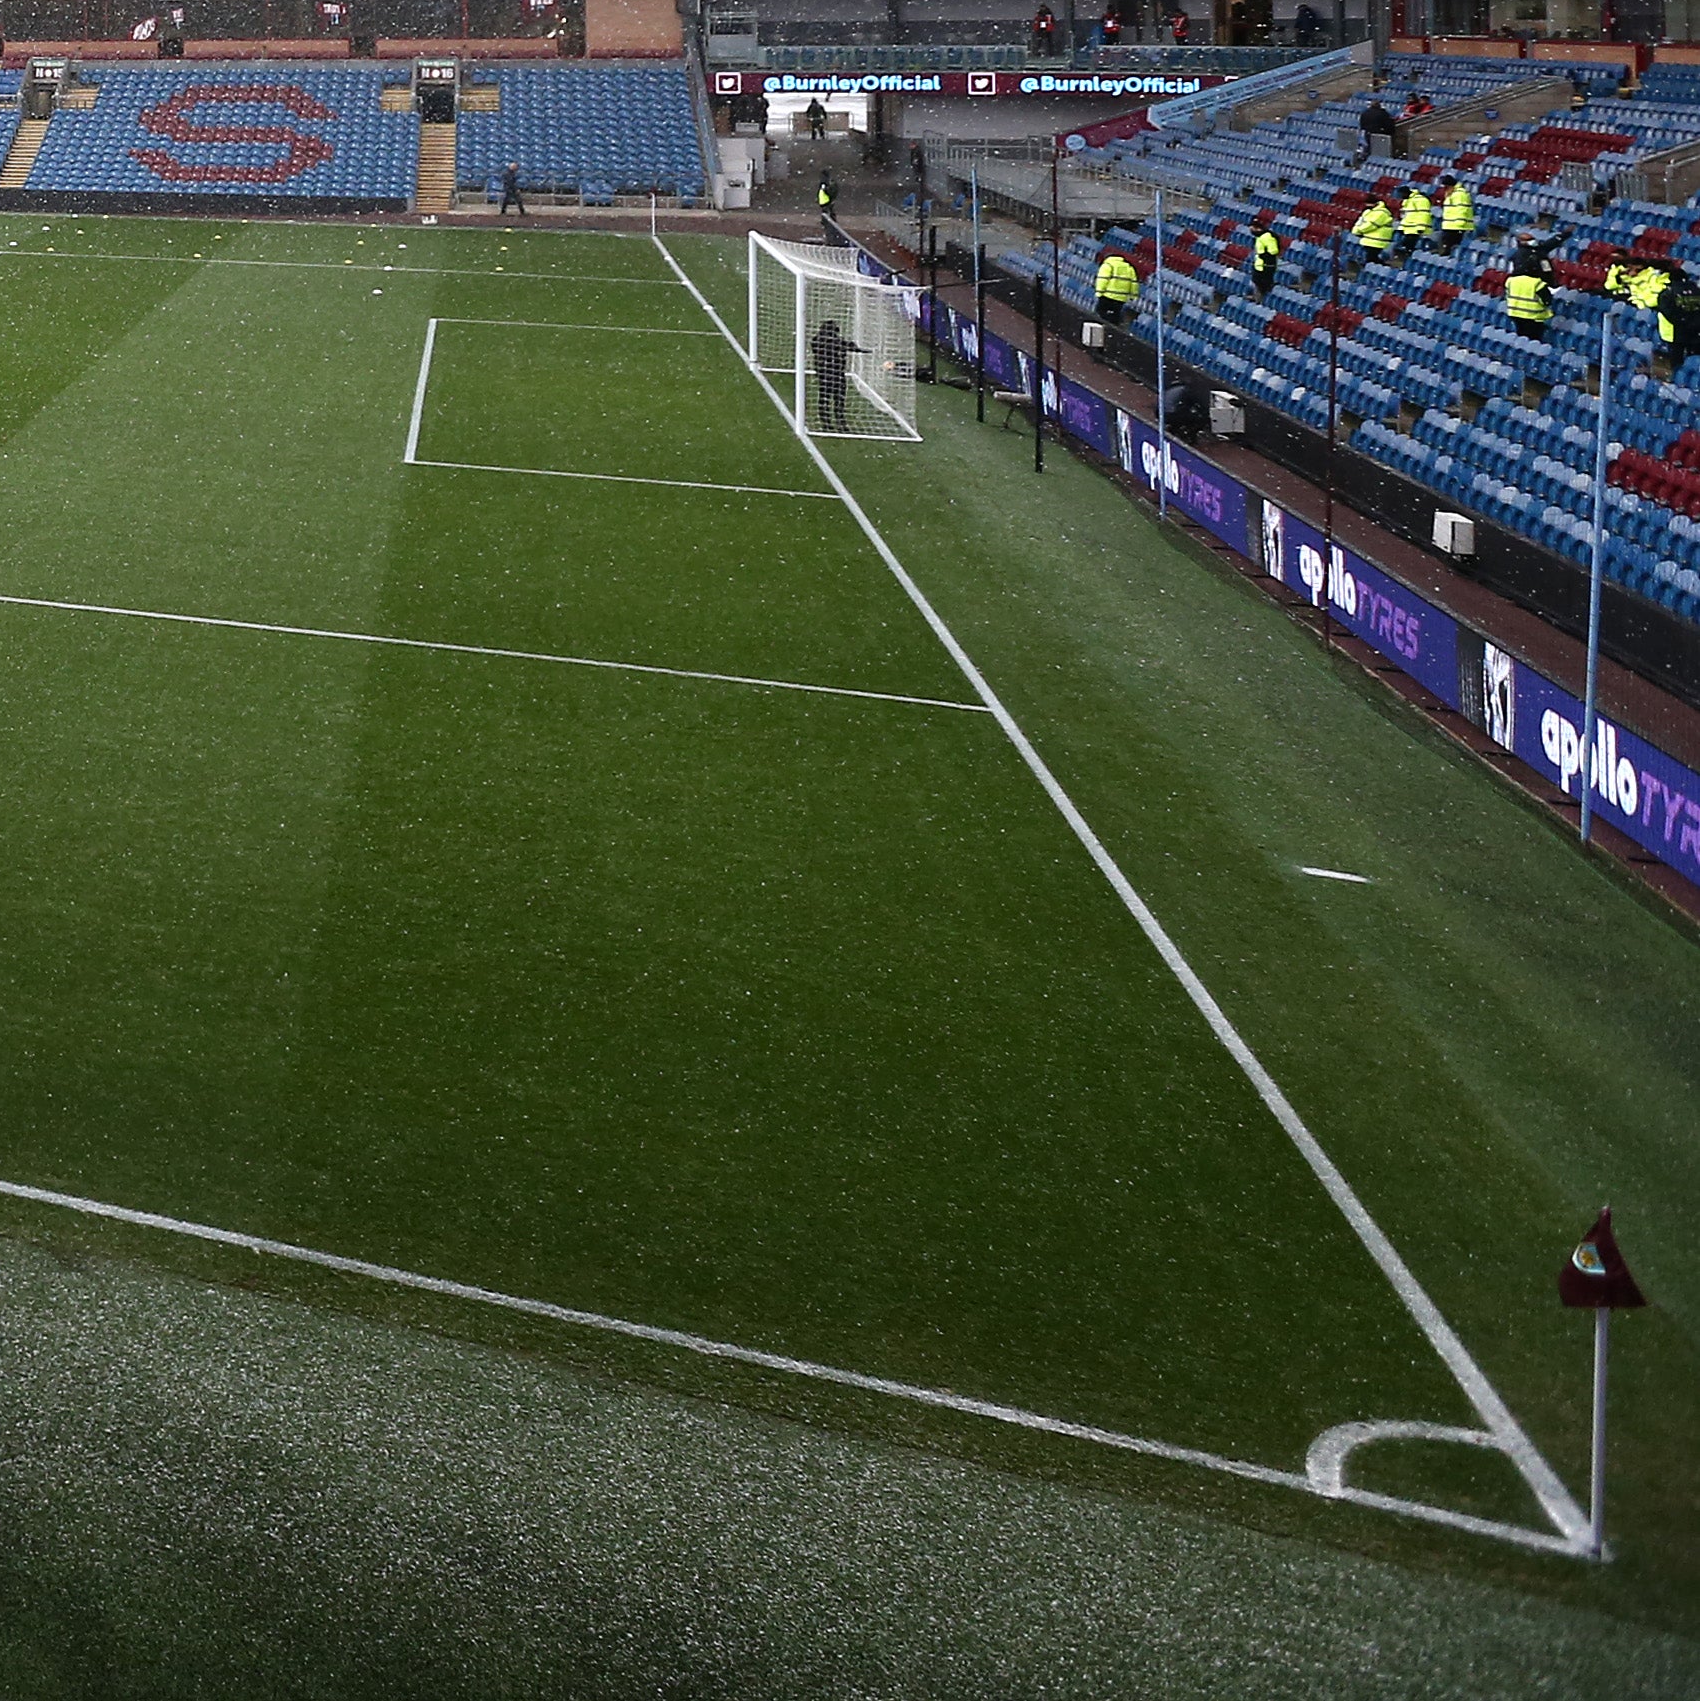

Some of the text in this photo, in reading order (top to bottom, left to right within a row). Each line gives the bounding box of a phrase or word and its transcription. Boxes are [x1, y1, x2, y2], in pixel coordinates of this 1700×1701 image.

[763, 74, 942, 94] @BurnleyOfficial
[1019, 76, 1200, 96] @BurnleyOfficial
[1179, 463, 1223, 524] TYRES
[1356, 578, 1420, 660] TYRES
